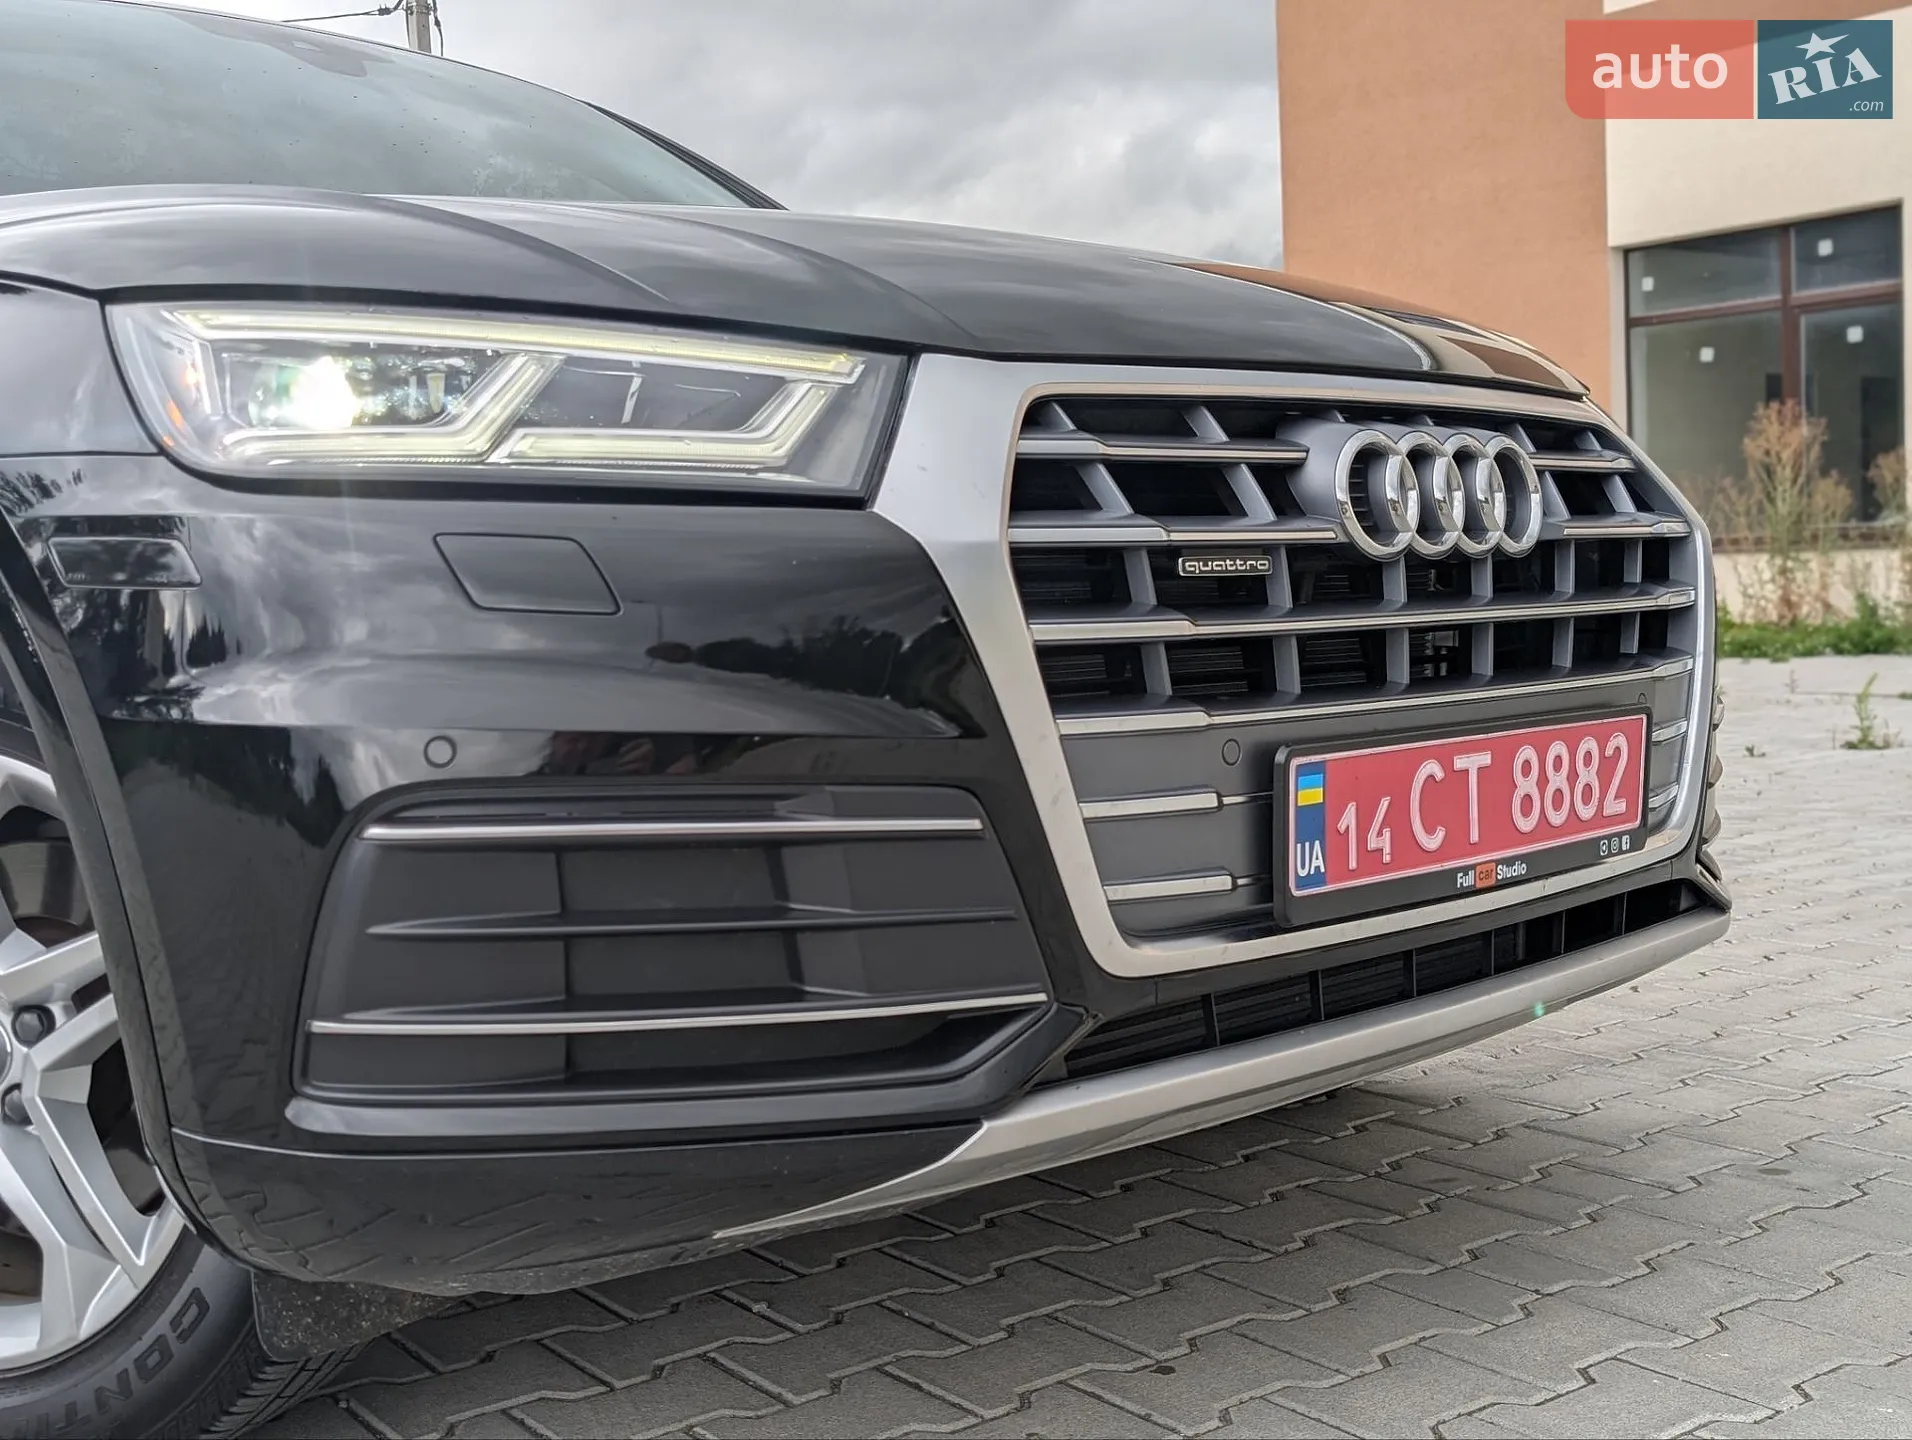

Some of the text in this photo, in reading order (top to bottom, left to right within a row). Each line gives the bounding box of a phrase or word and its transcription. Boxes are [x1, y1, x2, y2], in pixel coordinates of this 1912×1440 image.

[1185, 558, 1269, 574] quattro
[1337, 732, 1629, 870] 14 CT 8882
[1296, 840, 1325, 876] UA
[1457, 862, 1527, 888] Full car Studio
